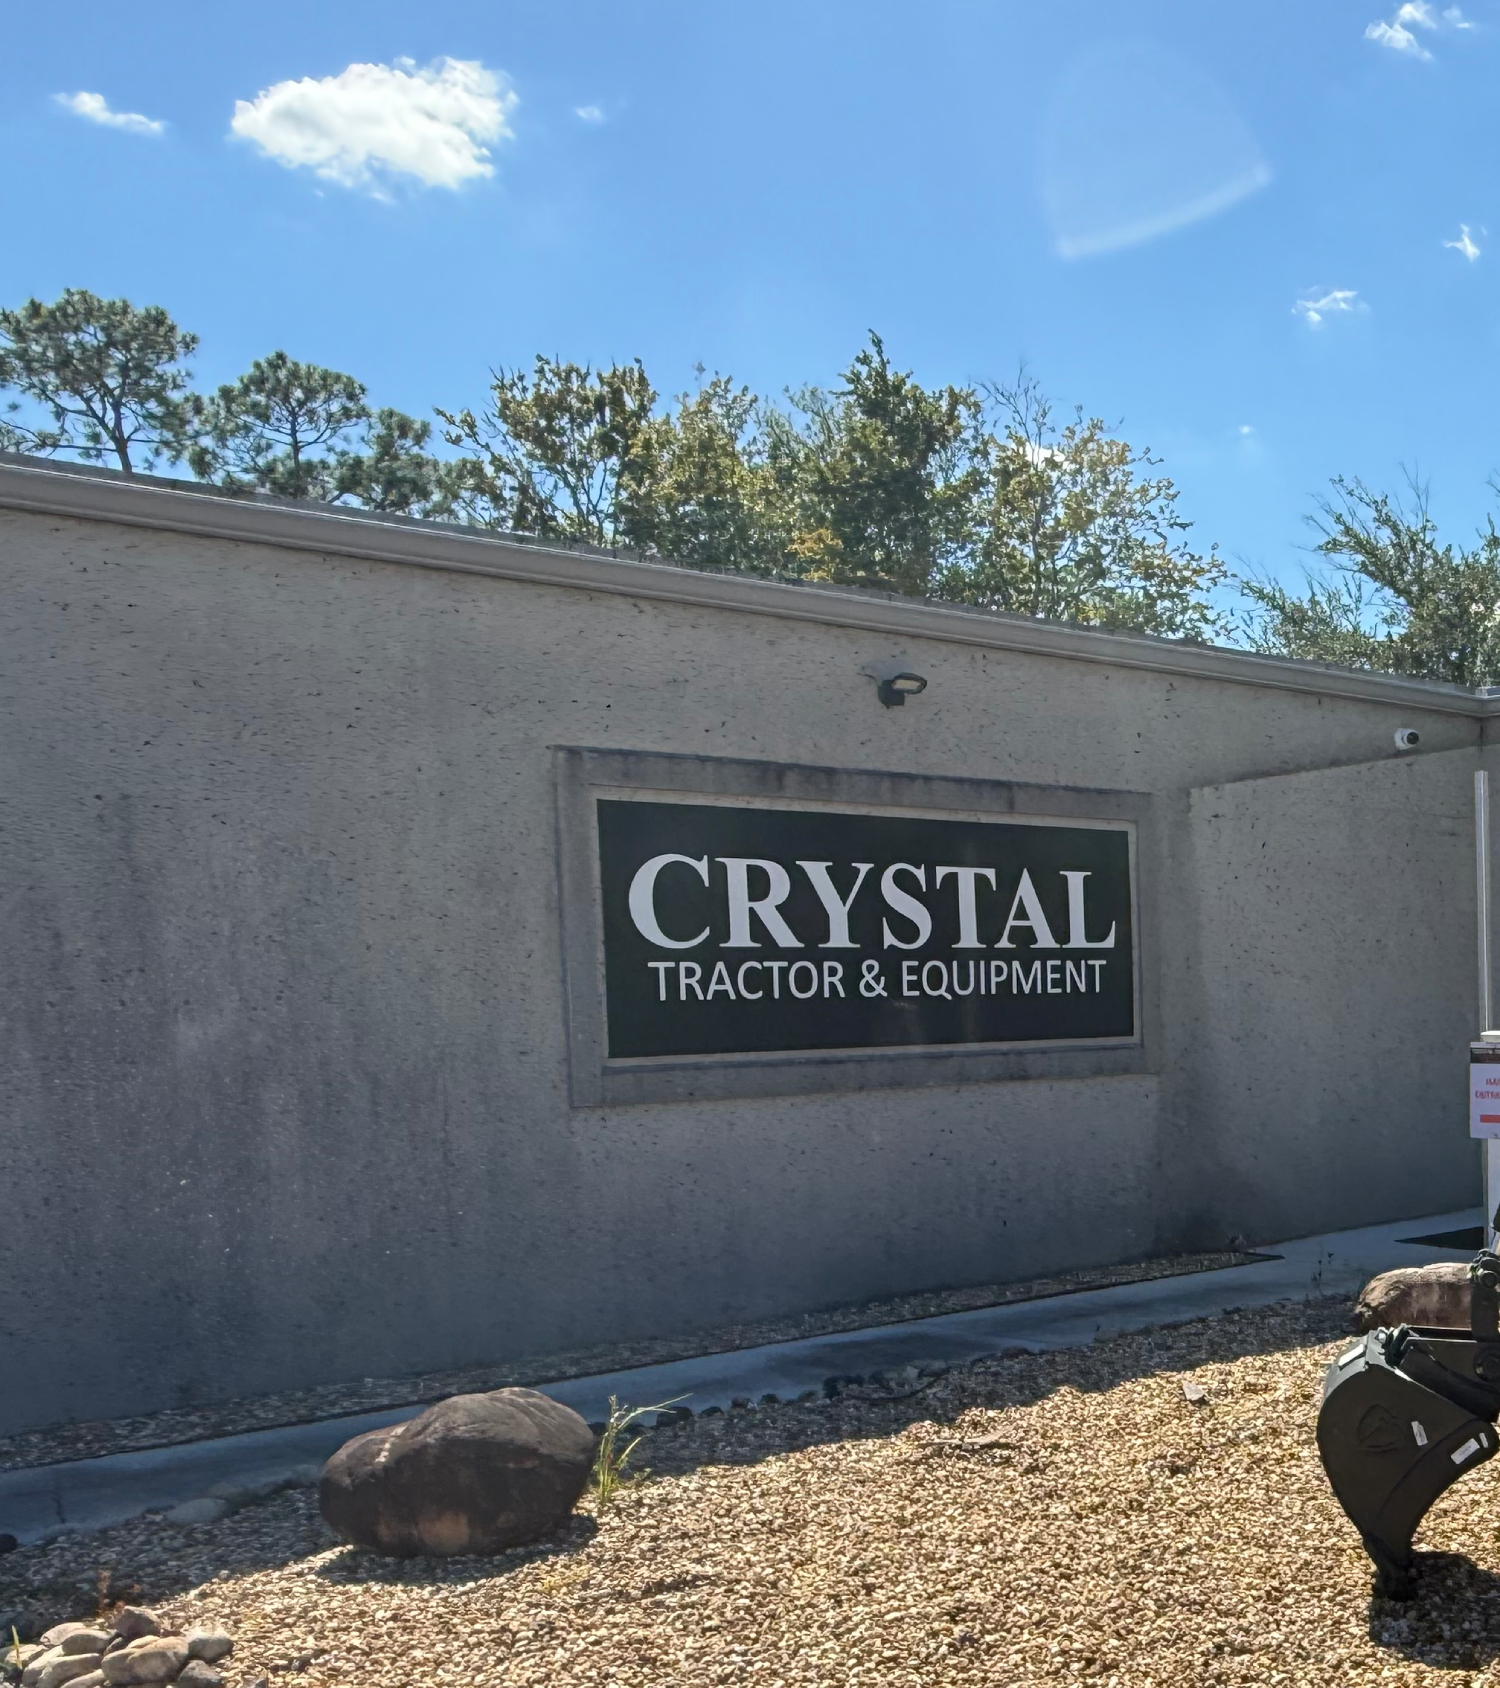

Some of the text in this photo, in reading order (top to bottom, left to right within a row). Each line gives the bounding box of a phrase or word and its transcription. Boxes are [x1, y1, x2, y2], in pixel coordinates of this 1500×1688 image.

[628, 853, 1116, 950] CRYSTAL
[647, 959, 1107, 1001] TRACTOR & EQUIPMENT
